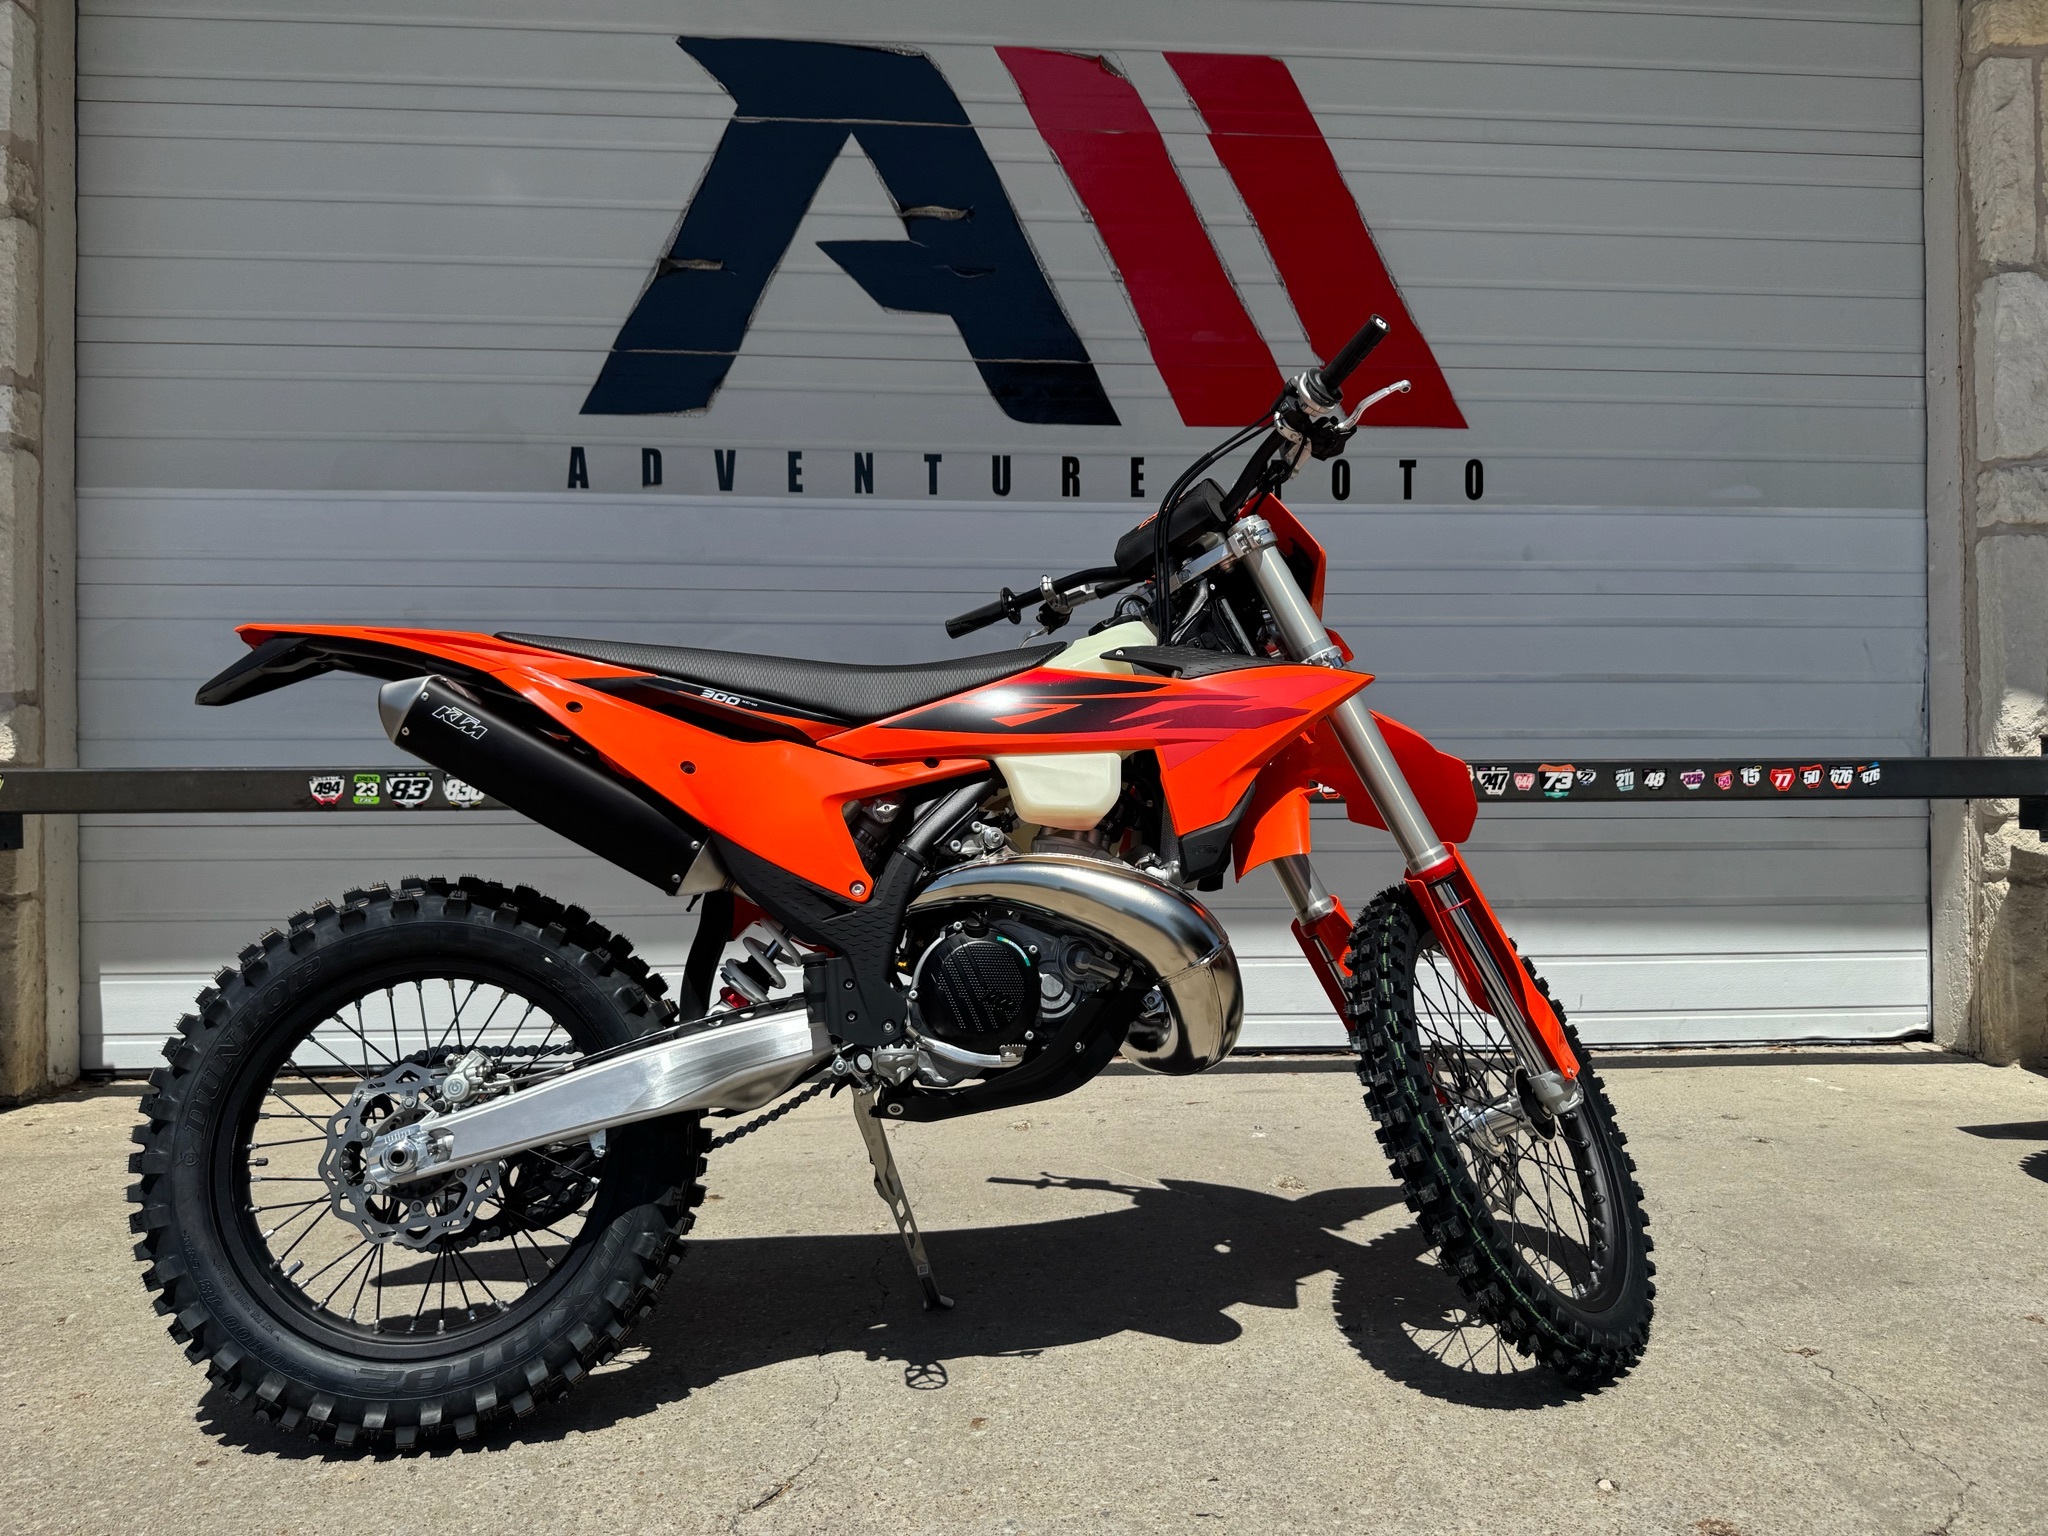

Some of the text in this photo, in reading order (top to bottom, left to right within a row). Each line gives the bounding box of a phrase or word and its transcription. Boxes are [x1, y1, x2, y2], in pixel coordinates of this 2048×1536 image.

[568, 446, 1485, 501] ADVENTURE OTO
[700, 688, 741, 706] 300
[431, 705, 489, 740] KTM
[1481, 773, 1508, 790] 247
[1543, 772, 1574, 789] 73
[1578, 772, 1594, 782] 22
[1615, 771, 1635, 787] 211
[1643, 772, 1666, 787] 48
[1774, 773, 1792, 787] 77
[1803, 769, 1820, 785] 50
[313, 781, 341, 795] 494
[355, 782, 379, 797] 23
[389, 779, 431, 800] 83
[183, 955, 324, 1139] DUNLOP
